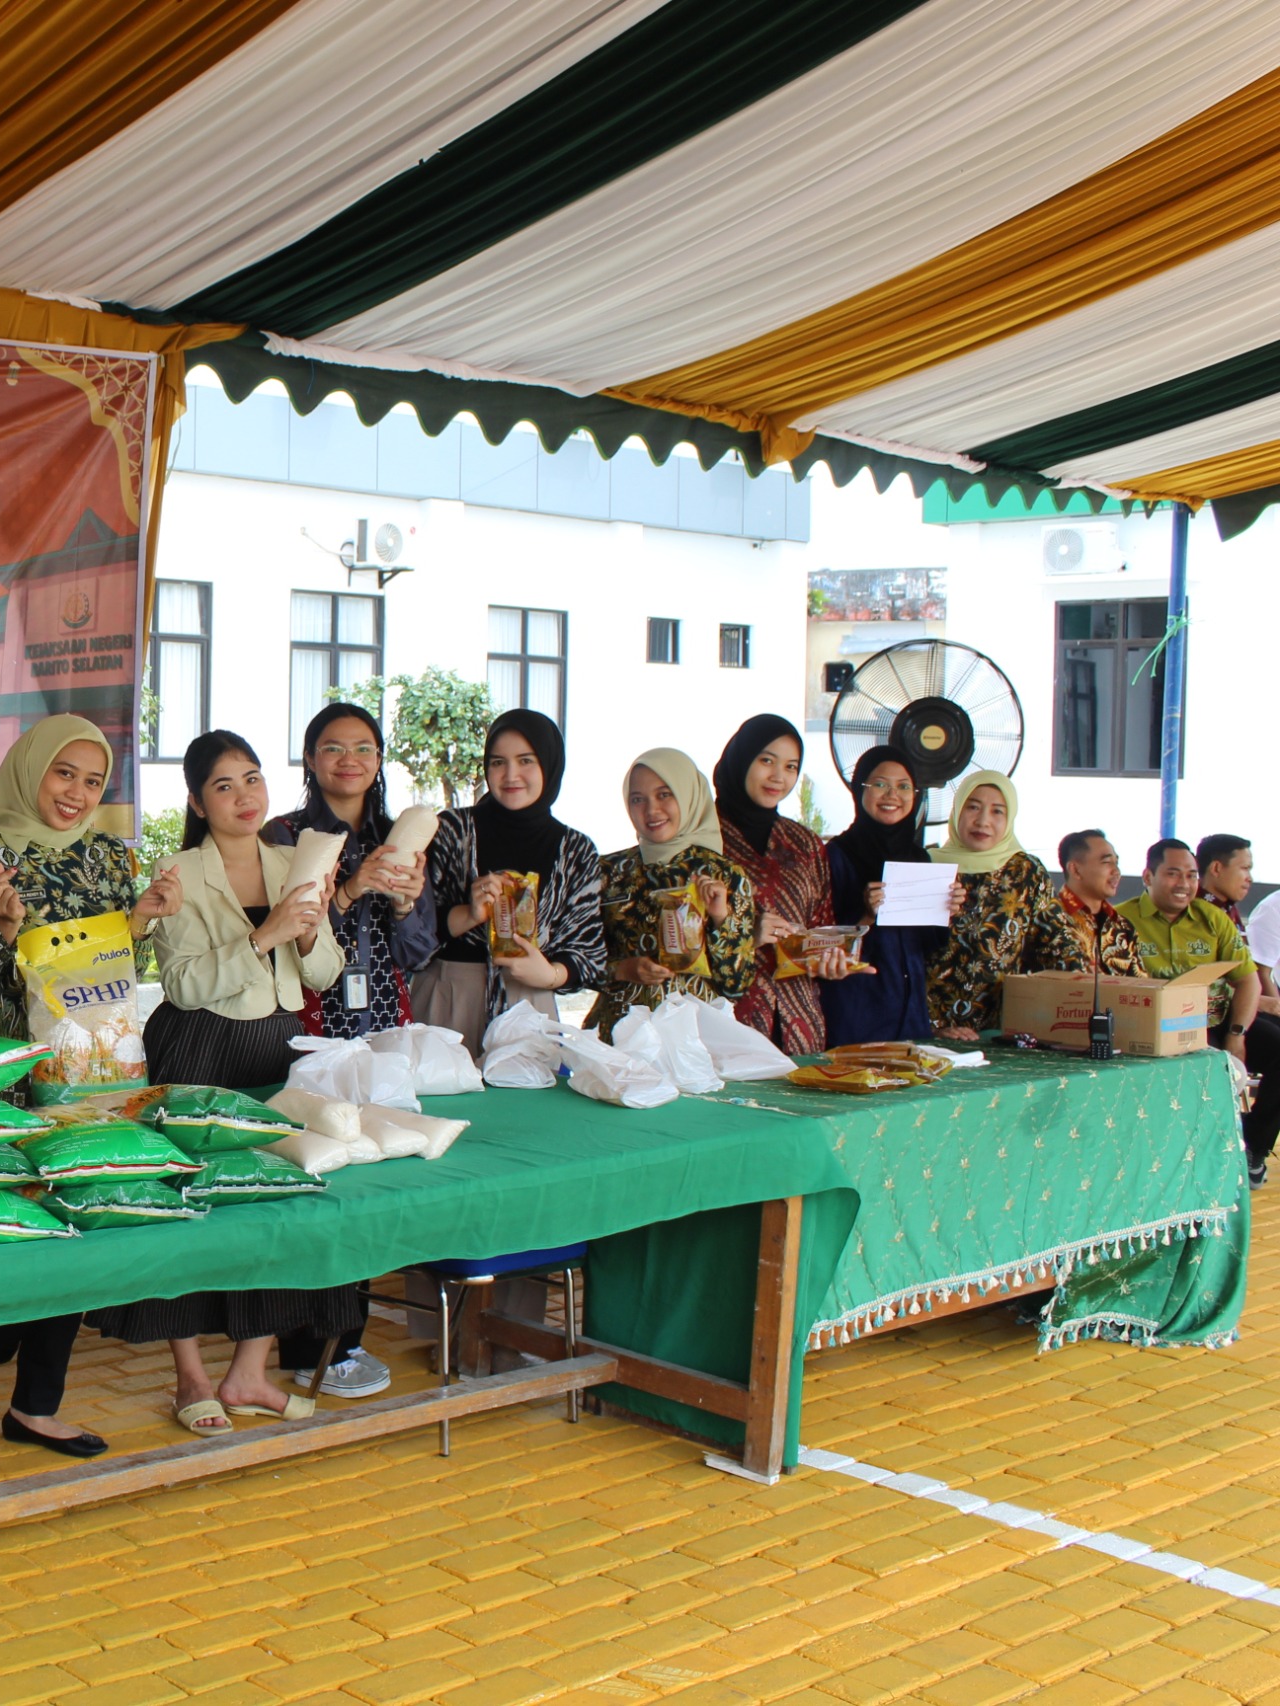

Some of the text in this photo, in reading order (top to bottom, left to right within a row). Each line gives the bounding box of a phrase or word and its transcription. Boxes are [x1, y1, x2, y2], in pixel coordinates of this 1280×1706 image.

[89, 634, 133, 652] NEGERI
[72, 654, 123, 673] SELATAN
[667, 913, 677, 949] Fortune
[99, 947, 131, 961] bulog
[62, 979, 131, 1008] SPHP
[1056, 1006, 1092, 1020] Fortun
